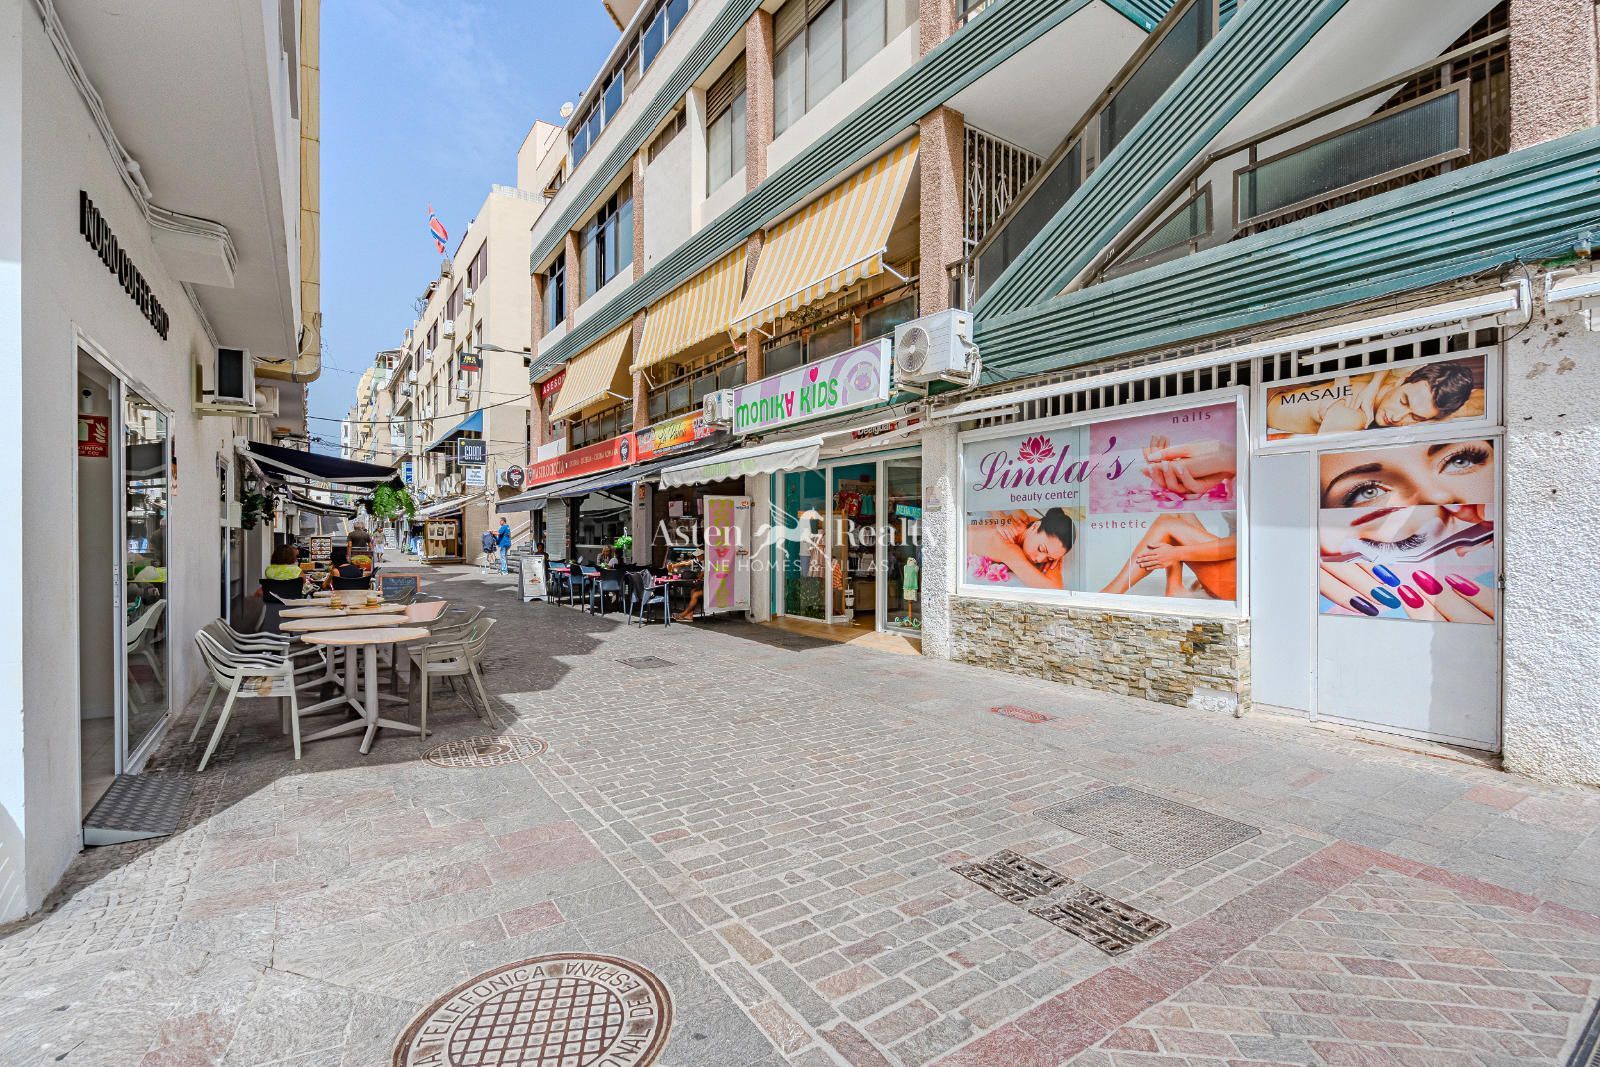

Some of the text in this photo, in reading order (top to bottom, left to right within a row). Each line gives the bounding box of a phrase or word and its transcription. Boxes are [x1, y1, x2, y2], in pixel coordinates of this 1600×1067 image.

[1281, 385, 1353, 405] MASAJE
[1172, 411, 1211, 424] nails
[972, 436, 1136, 492] Linda's
[1010, 489, 1079, 503] beauty center
[970, 519, 1012, 527] massage
[1091, 520, 1147, 529] esthetic
[416, 965, 545, 1047] TELEFONICA
[627, 995, 654, 1018] DE
